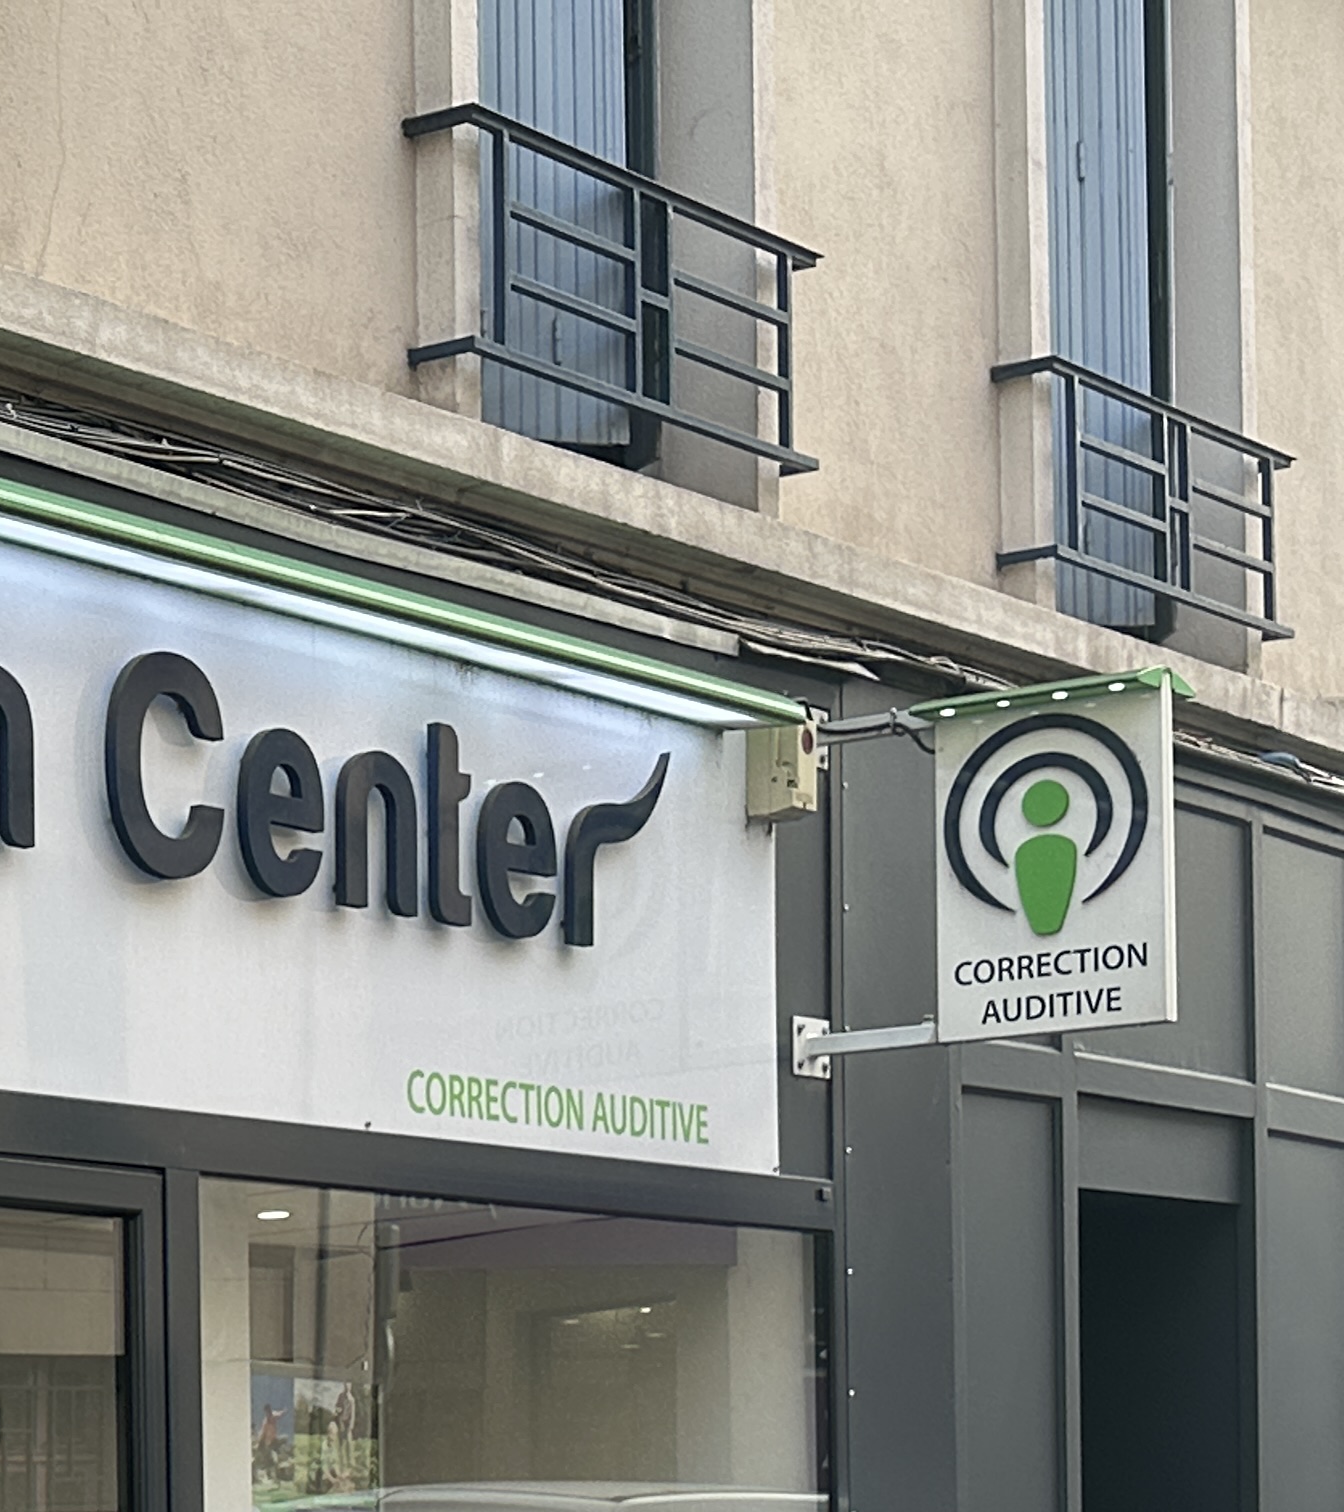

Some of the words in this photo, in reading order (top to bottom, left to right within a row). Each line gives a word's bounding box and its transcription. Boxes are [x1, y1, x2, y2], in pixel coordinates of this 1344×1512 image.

[106, 650, 671, 947] Center
[954, 942, 1149, 986] CORRECTION
[982, 987, 1122, 1025] AUDITIVE
[407, 1067, 585, 1132] CORRECTION
[592, 1090, 710, 1146] AUDITIVE
